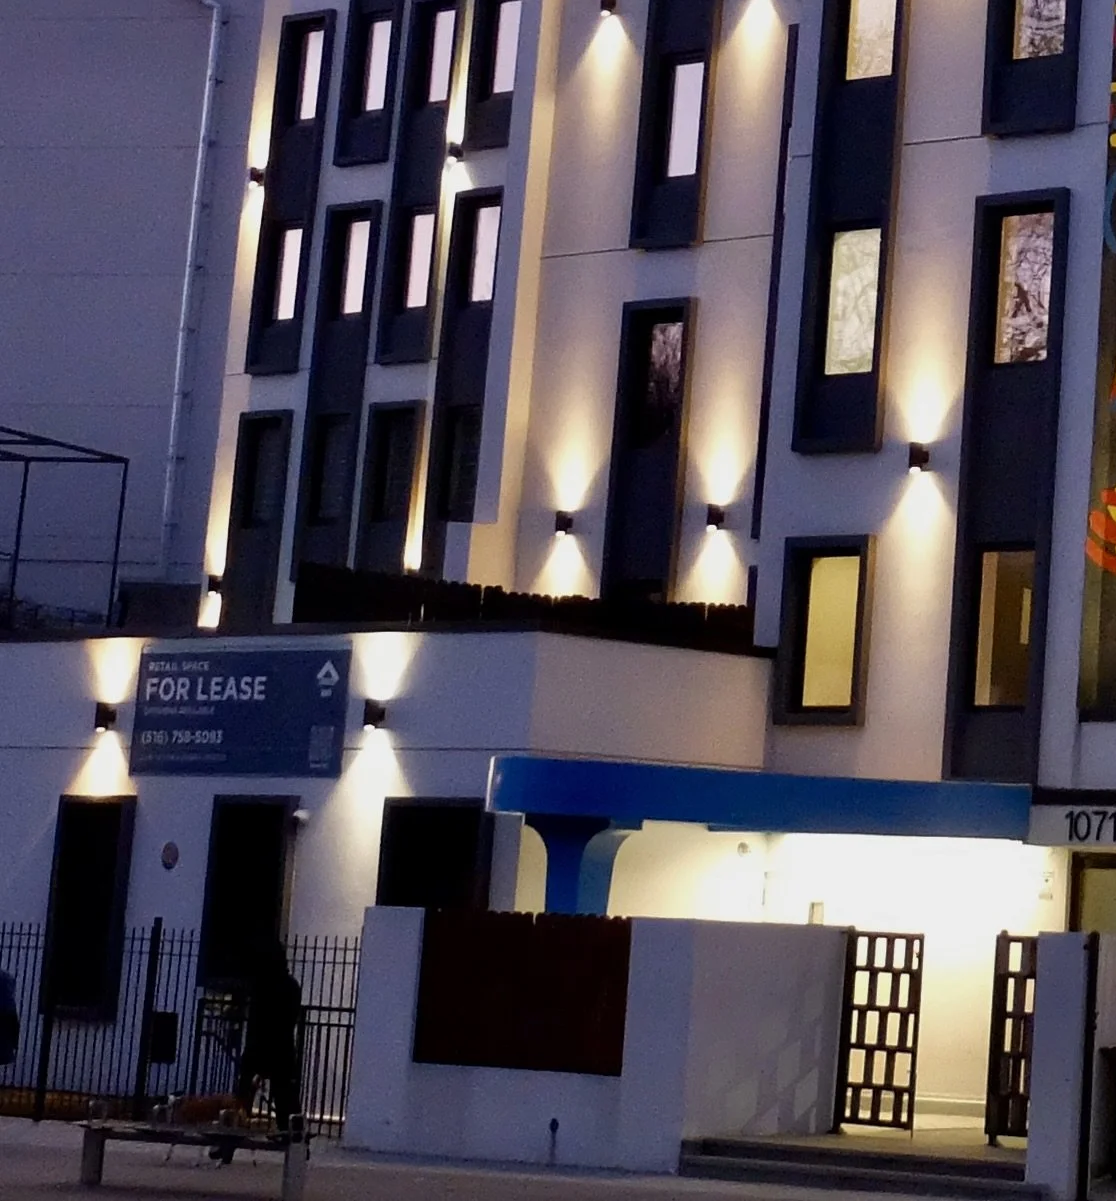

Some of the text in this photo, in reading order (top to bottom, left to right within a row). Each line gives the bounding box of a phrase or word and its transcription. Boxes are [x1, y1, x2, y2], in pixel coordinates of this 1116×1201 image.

[145, 676, 268, 701] FOR LEASE
[141, 730, 169, 745] (516)
